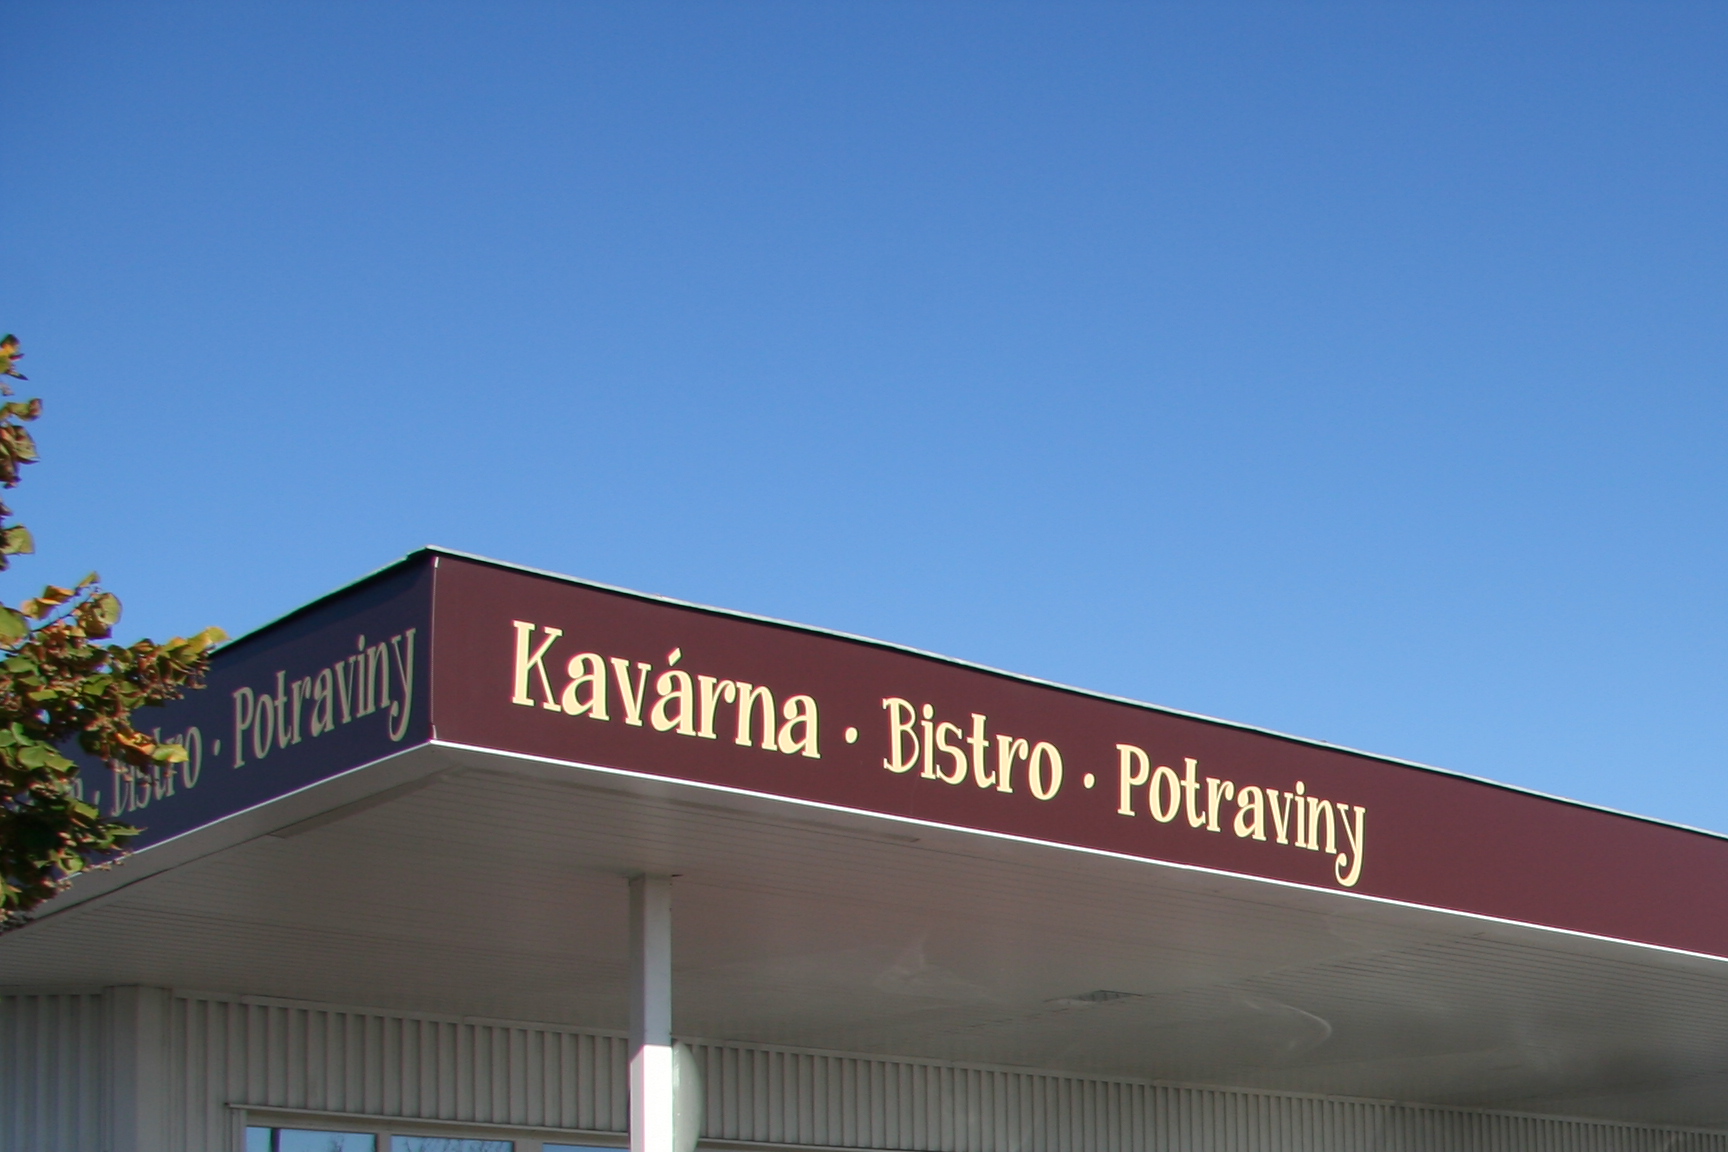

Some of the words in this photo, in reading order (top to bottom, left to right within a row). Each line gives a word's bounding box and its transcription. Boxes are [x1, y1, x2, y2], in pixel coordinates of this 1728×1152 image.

[233, 627, 417, 769] Potraviny
[512, 620, 821, 760] Kavárna
[883, 697, 1063, 801] Bistro
[1116, 743, 1366, 887] Potraviny
